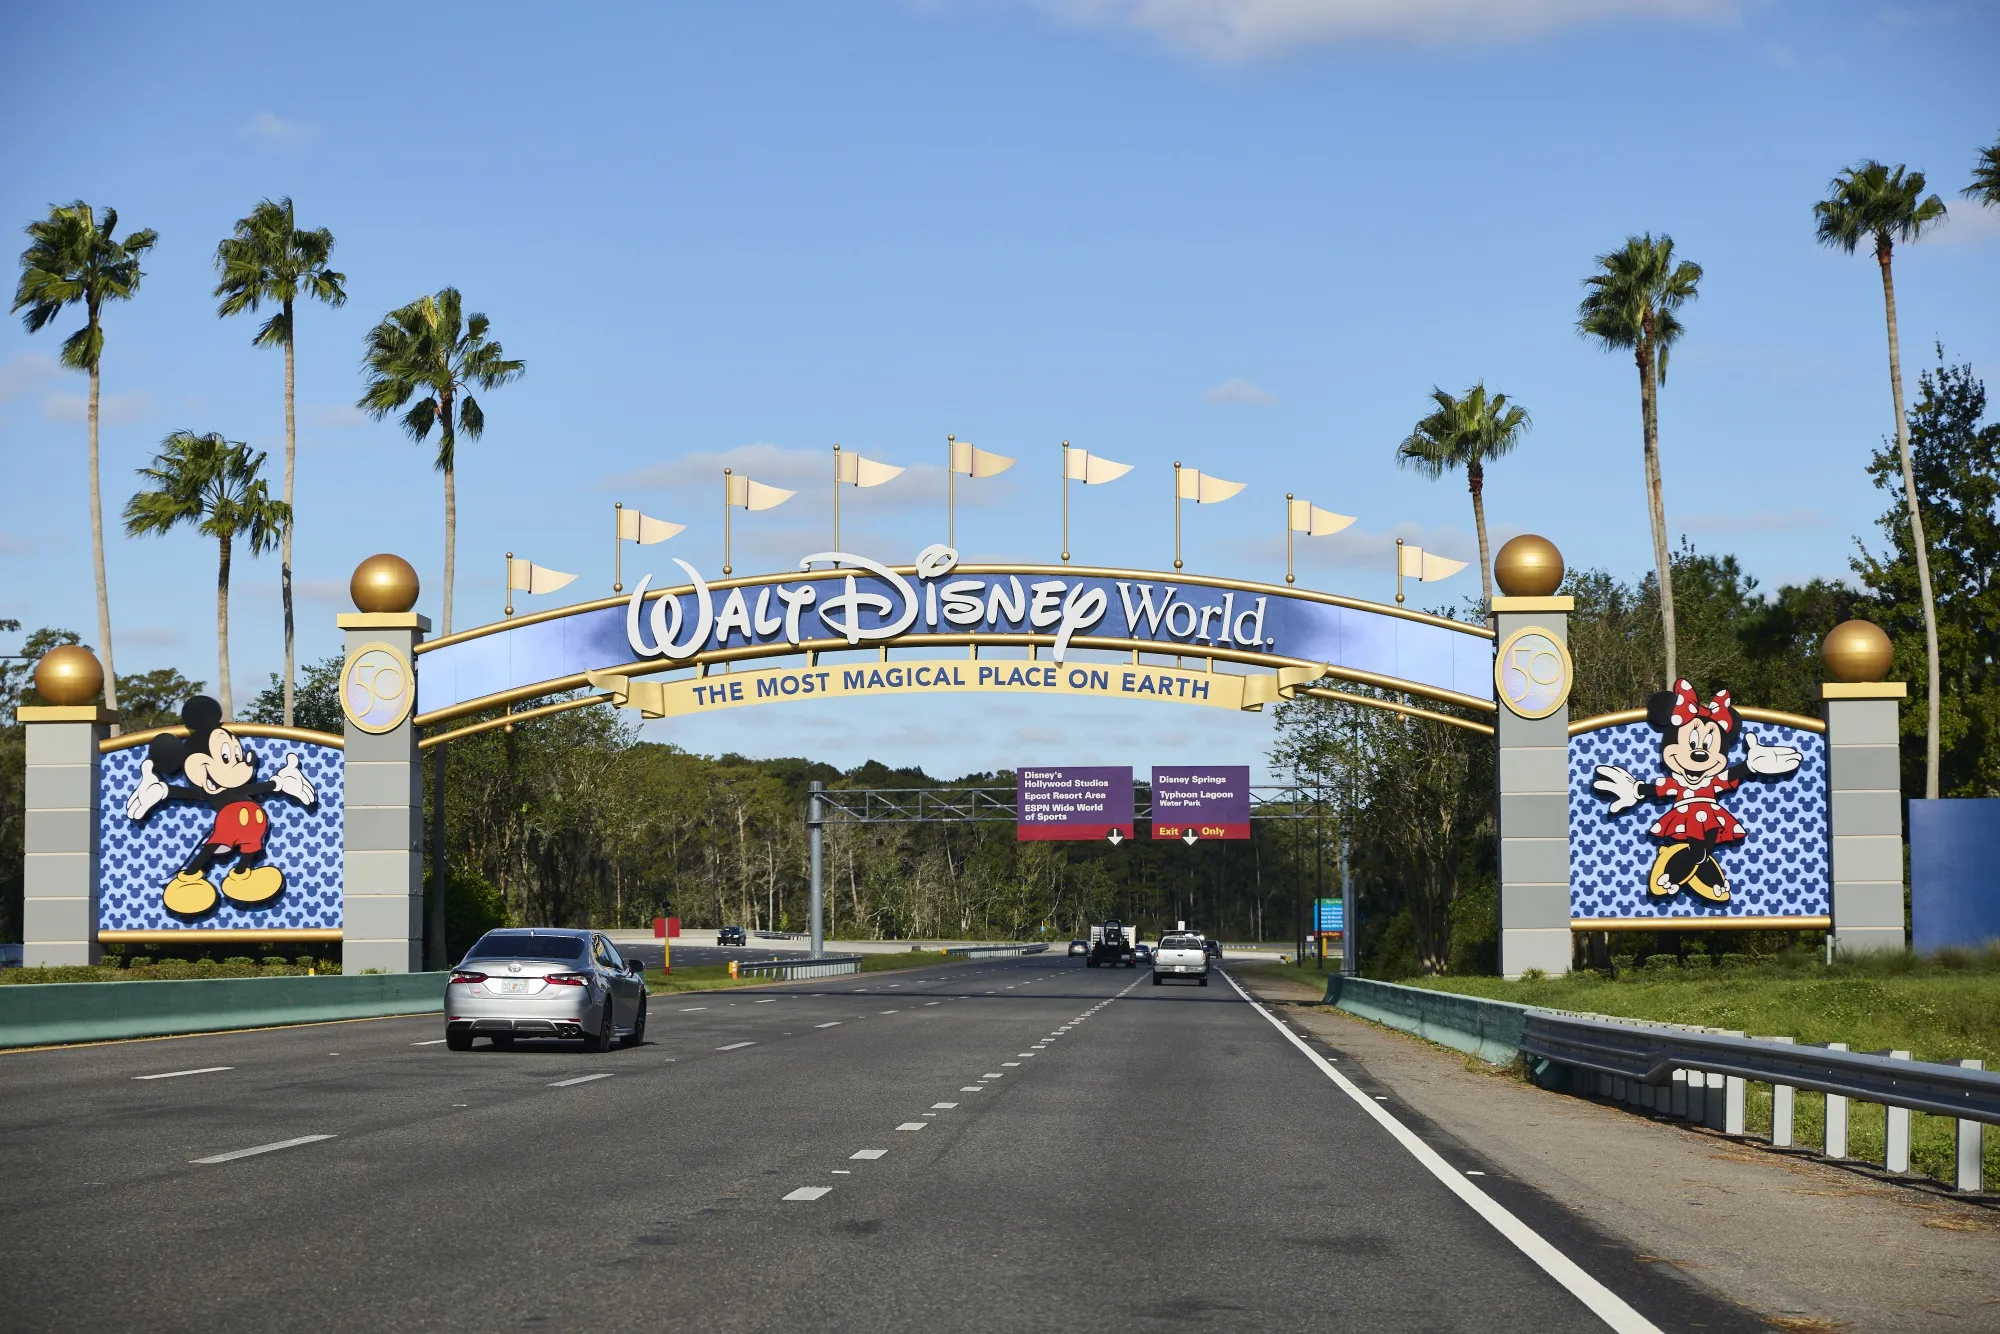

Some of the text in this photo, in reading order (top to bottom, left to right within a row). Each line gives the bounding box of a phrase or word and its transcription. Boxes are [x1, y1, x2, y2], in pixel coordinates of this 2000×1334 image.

[1512, 646, 1563, 703] 50
[693, 666, 1210, 706] THE MOST MAGICAL PLACE ON EARTH
[356, 664, 406, 718] 50
[1024, 771, 1063, 780] Disney's
[1159, 775, 1227, 784] Disney Springs
[1024, 779, 1109, 789] Hollywood Studios
[1024, 792, 1051, 801] Epcot
[1084, 791, 1106, 799] Area
[1159, 790, 1234, 799] Typhoon Lagoon
[1024, 804, 1050, 812] ESPN
[1076, 803, 1104, 811] World
[1159, 799, 1201, 807] Water Park
[1037, 813, 1067, 822] Sports
[1159, 826, 1225, 837] Exit Only
